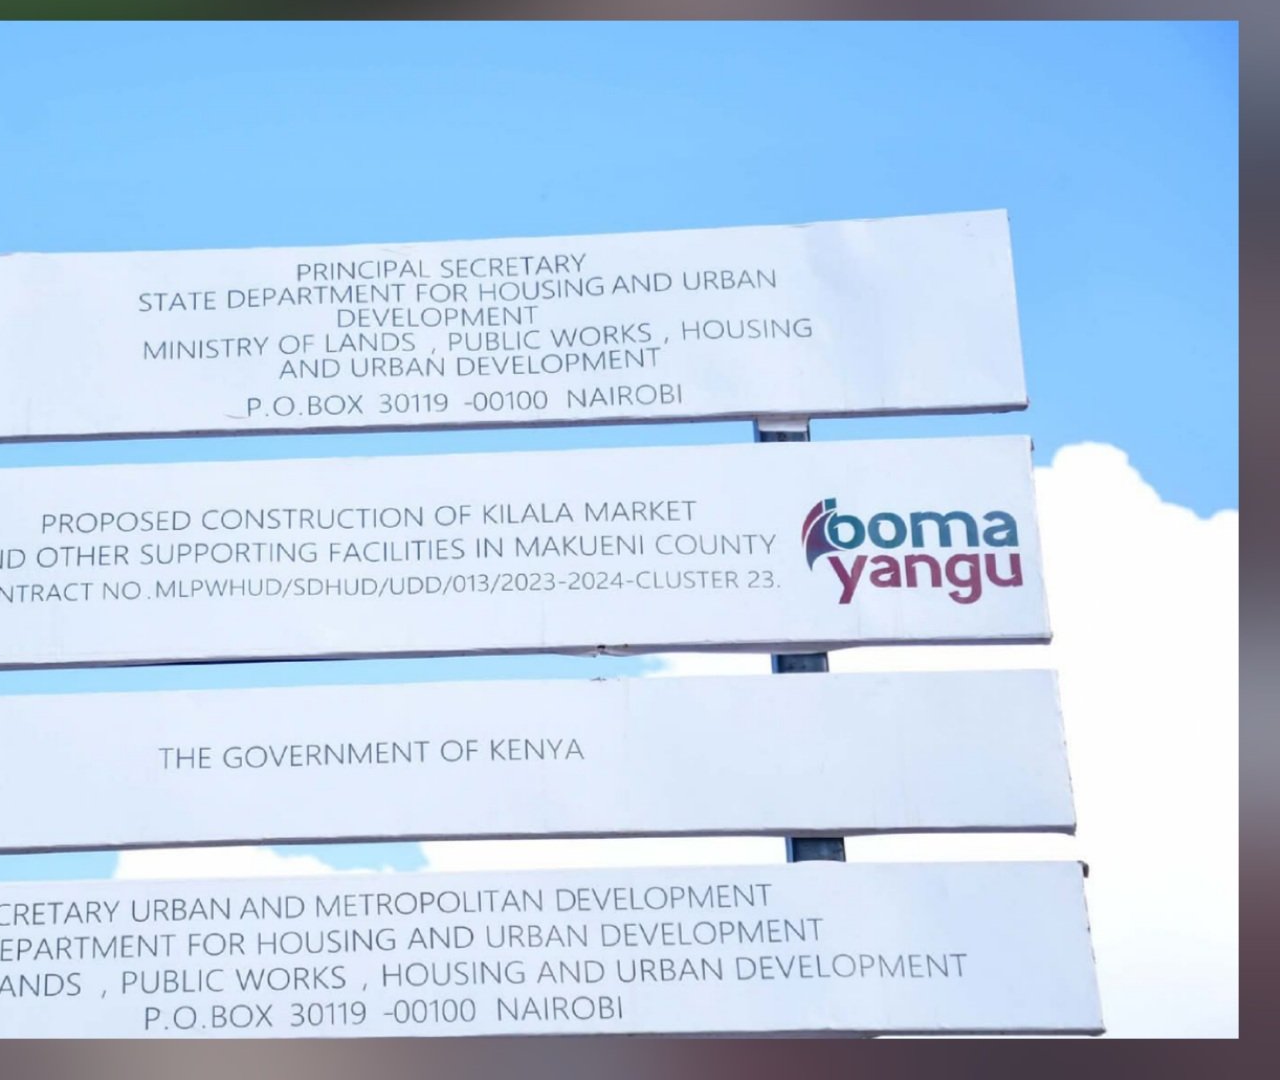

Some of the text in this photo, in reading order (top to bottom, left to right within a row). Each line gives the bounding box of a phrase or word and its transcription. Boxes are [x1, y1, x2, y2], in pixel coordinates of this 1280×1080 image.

[297, 252, 587, 282] PRINCIPAL SECRETARY
[139, 269, 776, 312] STATE DEPARTMENT FOR HOUSING AND URBAN
[337, 305, 538, 328] DEVELOPMENT
[144, 336, 269, 360] MINISTRY
[278, 334, 314, 355] OF
[326, 332, 415, 353] LANDS
[449, 330, 540, 351] PUBLIC
[550, 322, 652, 348] WORKS
[682, 318, 812, 341] HOUSING
[279, 346, 661, 379] AND URBAN DEVELOPMENT
[379, 393, 448, 413] 30119
[464, 390, 548, 412] -00100
[567, 384, 682, 408] NAIROBI
[42, 500, 696, 534] PROPOSED CONSTRUCTION OF KILALA MARKET
[808, 497, 1019, 550] boma
[36, 545, 129, 568] OTHER
[140, 542, 317, 565] SUPPORTING
[330, 538, 465, 563] FACILITIES
[476, 537, 503, 558] IN
[515, 535, 643, 557] MAKUENI
[655, 534, 776, 555] COUNTY
[748, 570, 780, 588] 23.
[827, 553, 1024, 605] yangu
[158, 738, 584, 769] THE GOVERNMENT OF KENYA
[132, 897, 230, 922] URBAN
[240, 896, 305, 920] AND
[316, 889, 543, 918] METROPOLITAN
[556, 884, 772, 912] DEVELOPMENT
[189, 933, 245, 956] FOR
[258, 928, 396, 955] HOUSING
[408, 926, 474, 950] AND
[486, 924, 587, 948] URBAN
[601, 918, 823, 947] DEVELOPMENT
[122, 969, 224, 994] PUBLIC
[235, 965, 346, 991] WORKS
[382, 960, 525, 987] HOUSING
[537, 960, 605, 984] AND
[617, 958, 723, 983] URBAN
[736, 953, 967, 980] DEVELOPMENT
[291, 1001, 366, 1027] 30119
[384, 998, 476, 1024] -00100
[497, 996, 622, 1021] NAIROBI
